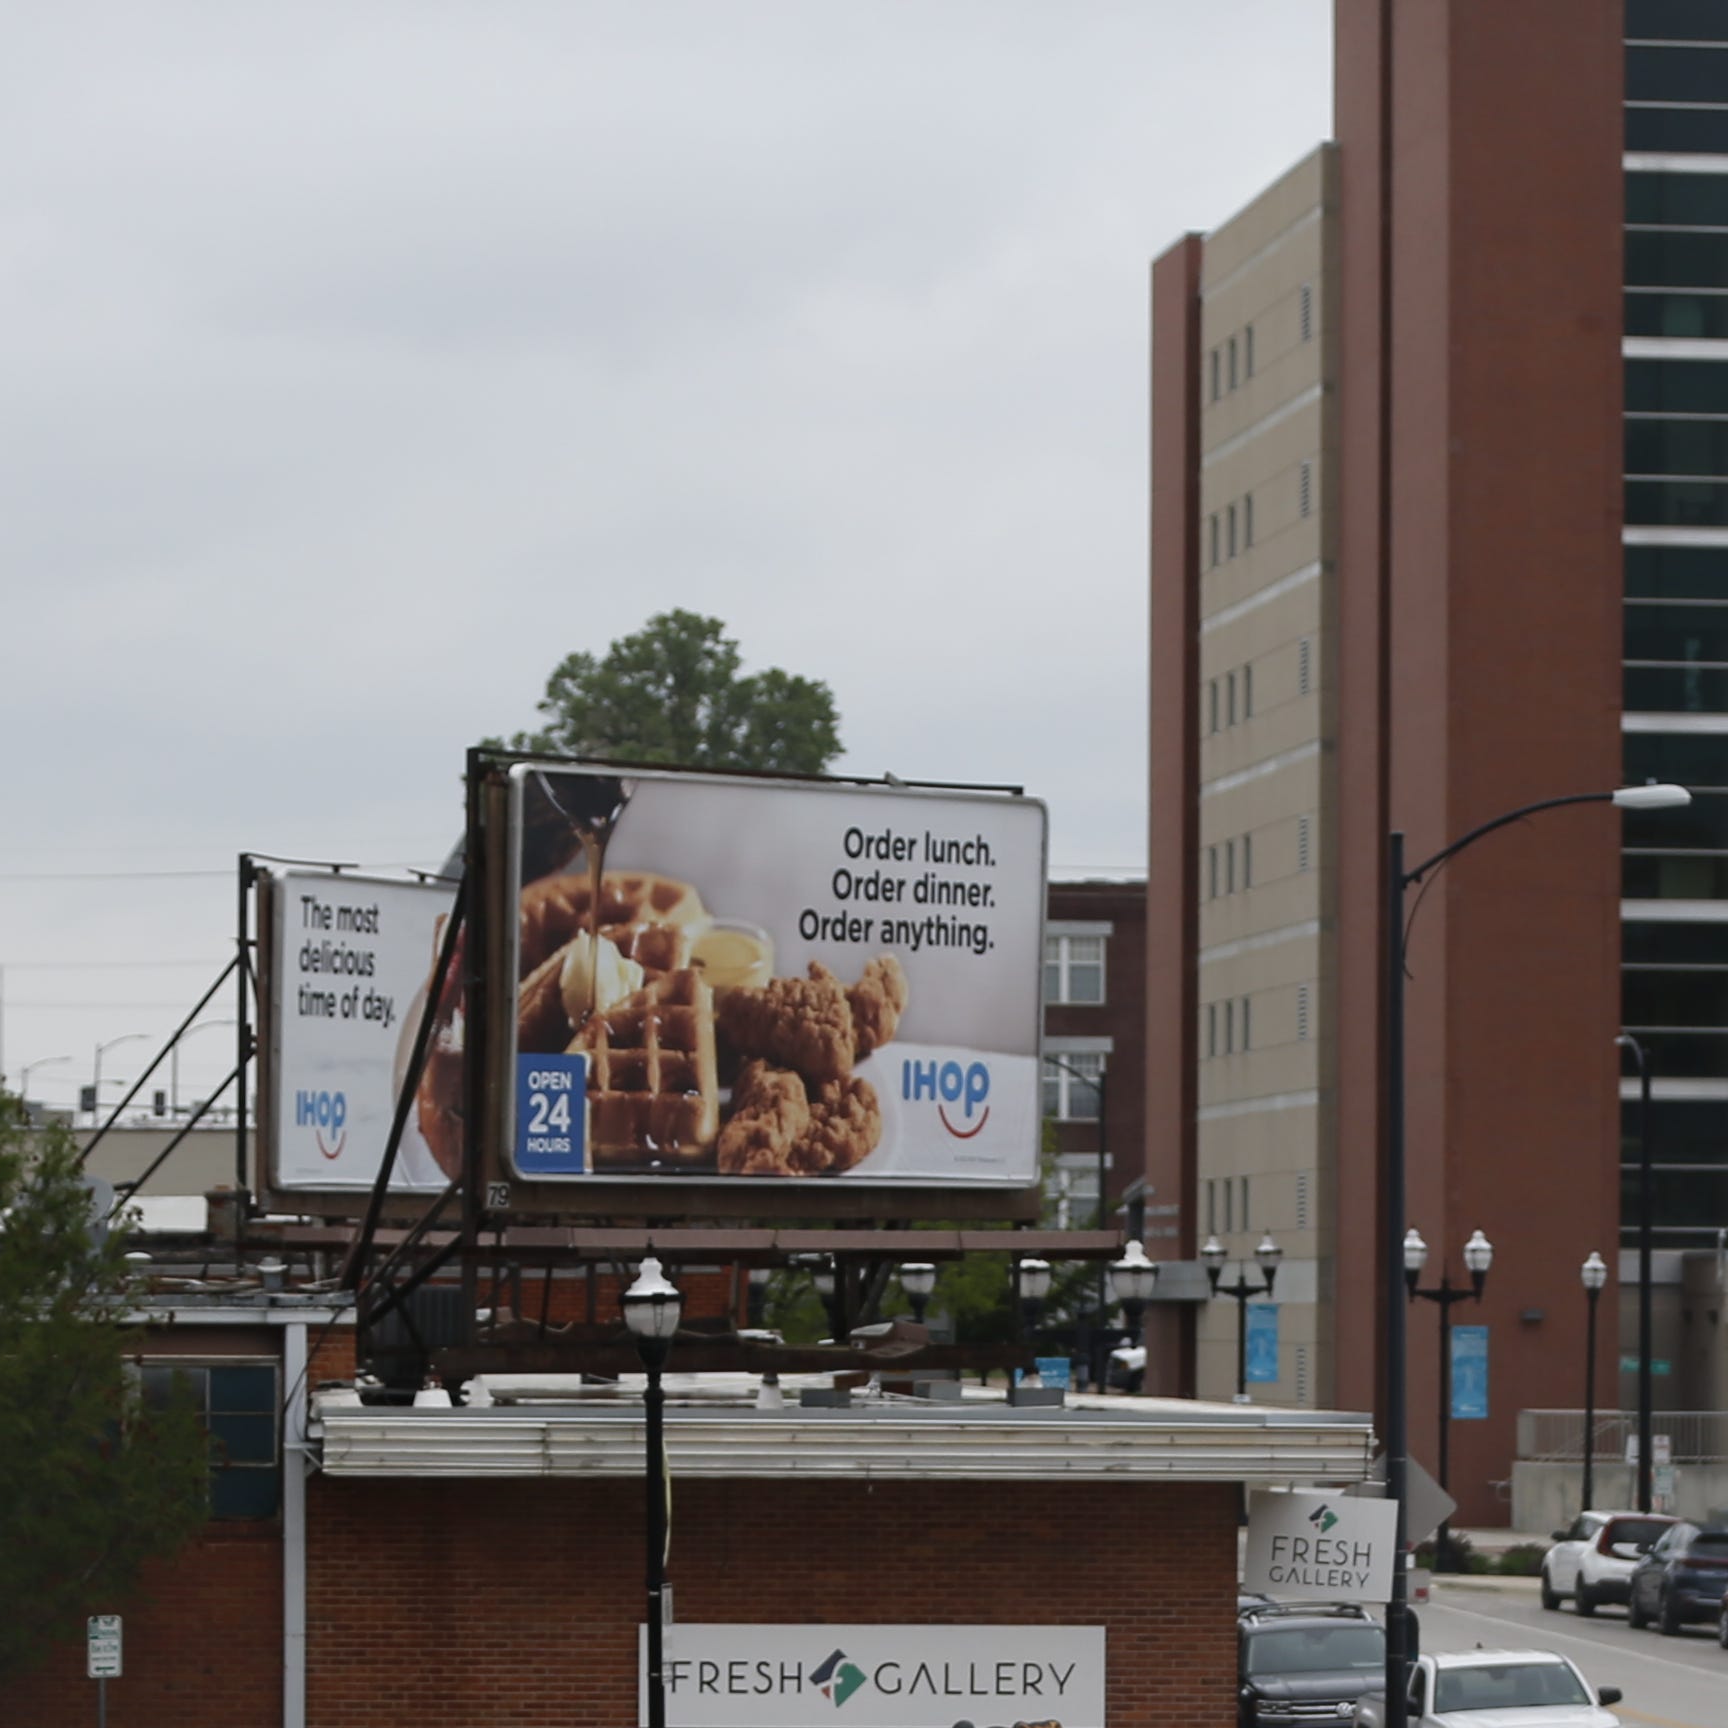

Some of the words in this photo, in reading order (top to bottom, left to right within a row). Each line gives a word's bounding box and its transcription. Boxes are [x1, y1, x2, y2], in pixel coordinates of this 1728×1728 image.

[844, 827, 916, 861] Order
[925, 831, 996, 866] lunch.
[832, 868, 906, 902] Order
[913, 872, 995, 908] dinner.
[300, 895, 333, 931] The
[337, 903, 379, 934] most
[799, 909, 874, 942] Order
[880, 914, 994, 954] anything.
[299, 939, 375, 977] delicious
[298, 983, 336, 1018] time
[340, 987, 360, 1018] of
[362, 988, 396, 1028] day.
[528, 1071, 572, 1089] OPEN
[903, 1059, 990, 1118] IHOP
[295, 1089, 347, 1141] IHOP
[528, 1092, 571, 1133] 24
[527, 1138, 571, 1153] HOURS
[489, 1185, 509, 1206] 79
[1271, 1536, 1373, 1567] FRESH
[1268, 1565, 1370, 1588] GALLERY
[670, 1661, 803, 1694] FRESH
[874, 1661, 1076, 1695] GALLERY
